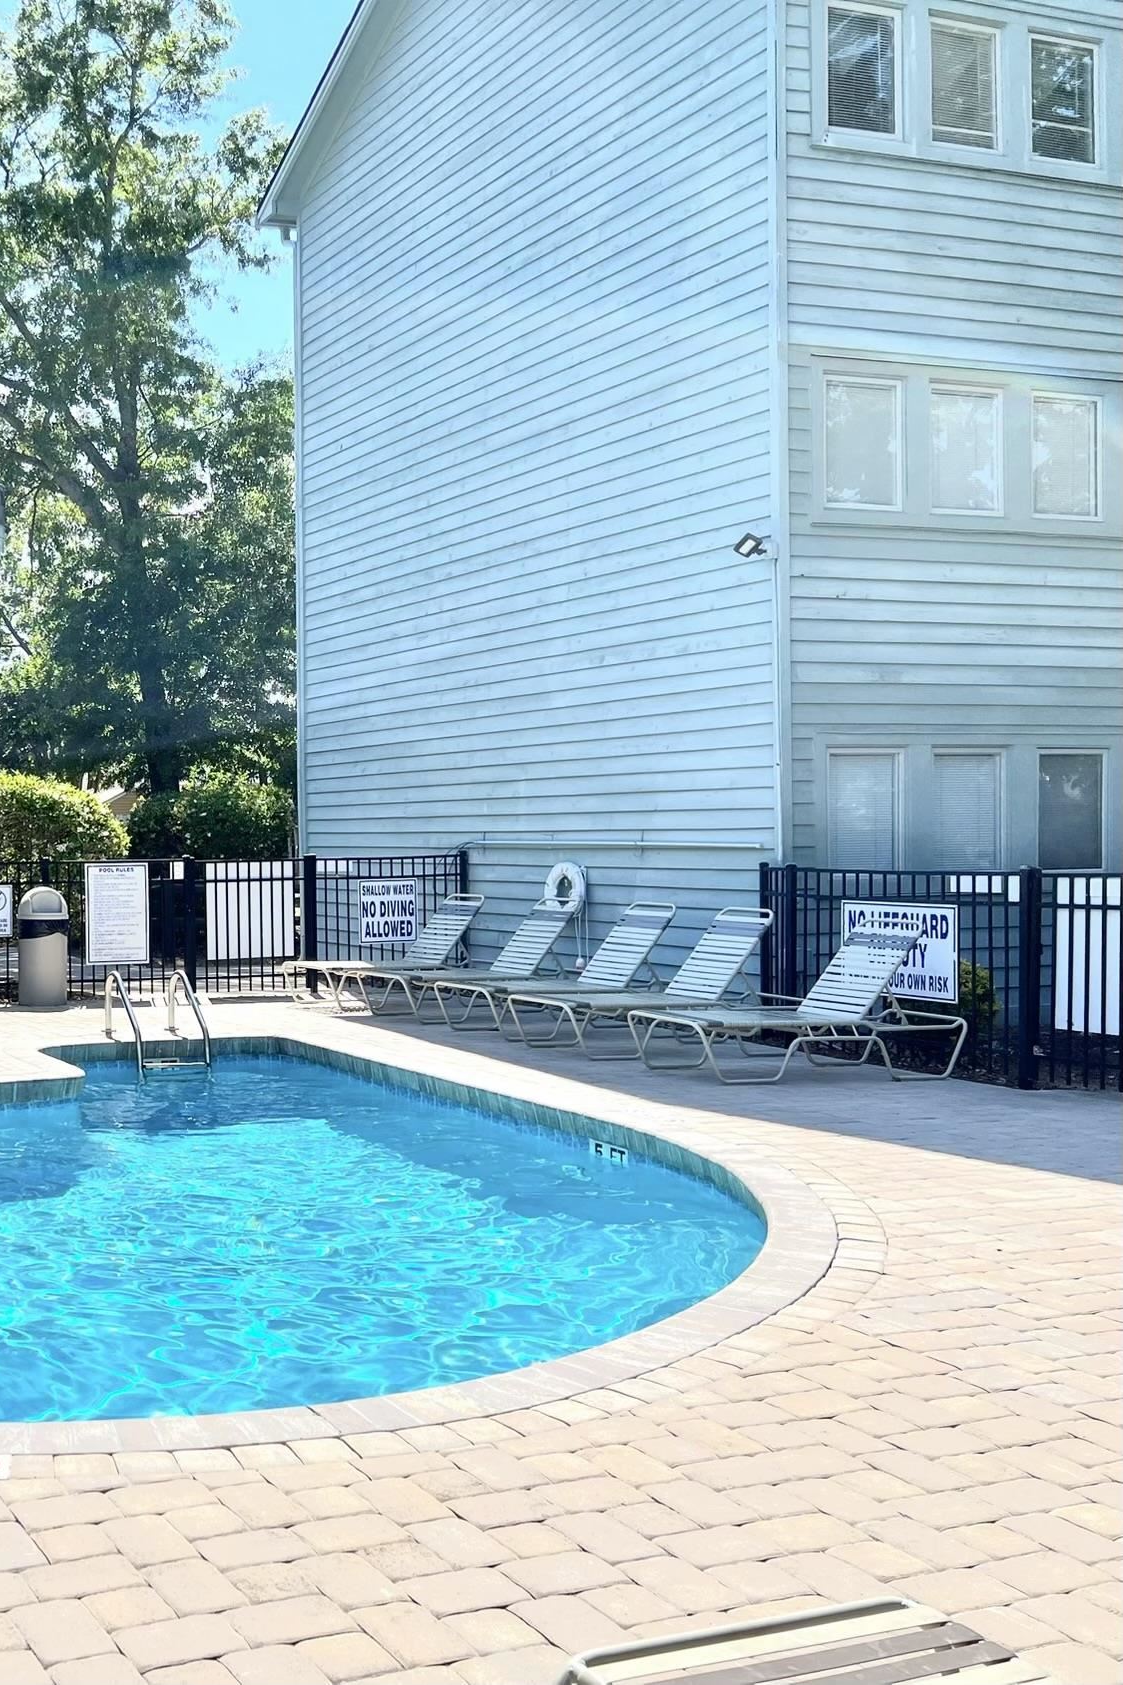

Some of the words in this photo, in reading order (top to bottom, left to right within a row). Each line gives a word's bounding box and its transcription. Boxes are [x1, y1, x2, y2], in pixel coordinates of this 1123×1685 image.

[362, 885, 391, 896] SHALLOW
[393, 884, 414, 895] WATER
[362, 900, 376, 918] NO
[380, 900, 414, 917] DIVING
[365, 920, 413, 938] ALLOWED
[907, 973, 926, 991] OWN
[929, 975, 949, 993] RISK
[595, 1142, 604, 1157] 5
[610, 1147, 626, 1165] FT
